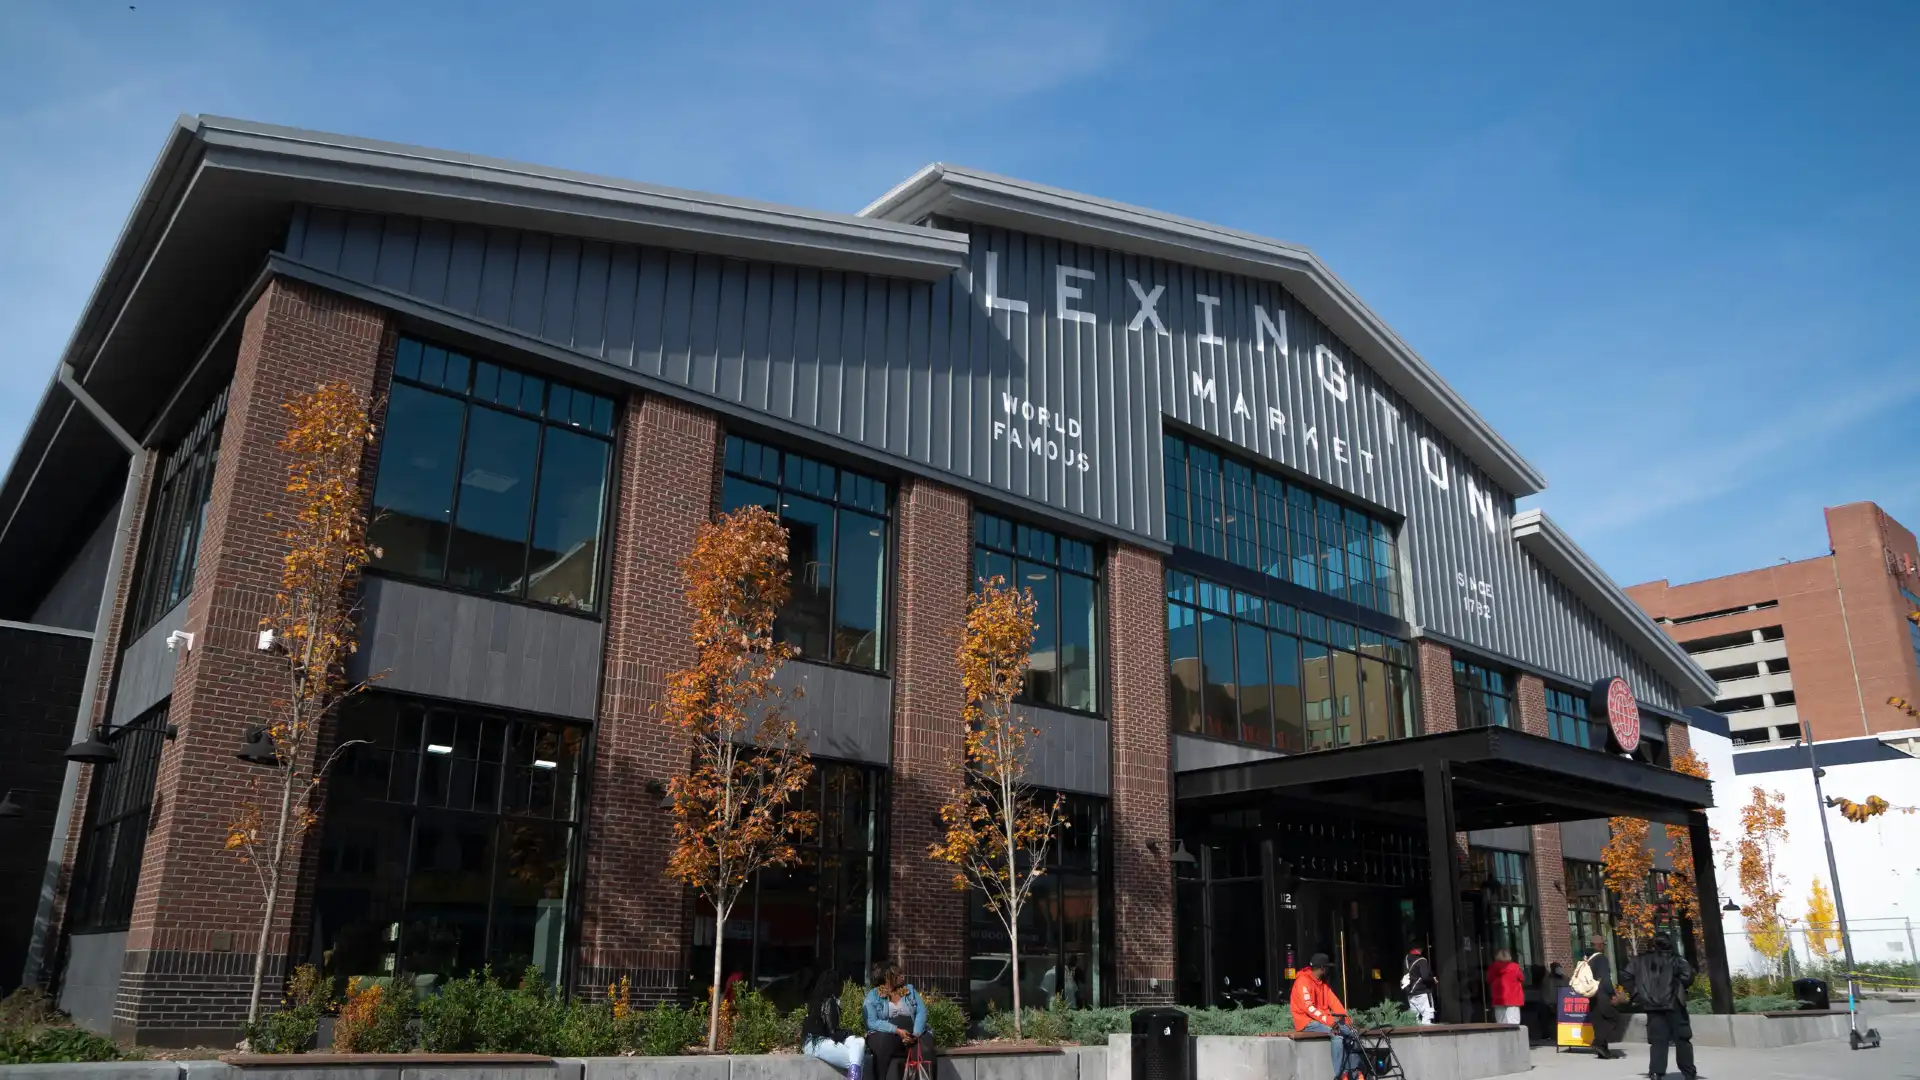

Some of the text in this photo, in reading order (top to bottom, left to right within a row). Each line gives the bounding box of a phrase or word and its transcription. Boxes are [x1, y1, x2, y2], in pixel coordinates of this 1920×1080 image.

[986, 251, 1496, 534] LEXINGTON
[1002, 391, 1081, 438] WORLD
[994, 420, 1090, 472] FAMOUS
[1192, 371, 1374, 475] MARKET
[1457, 571, 1493, 598] SNCE
